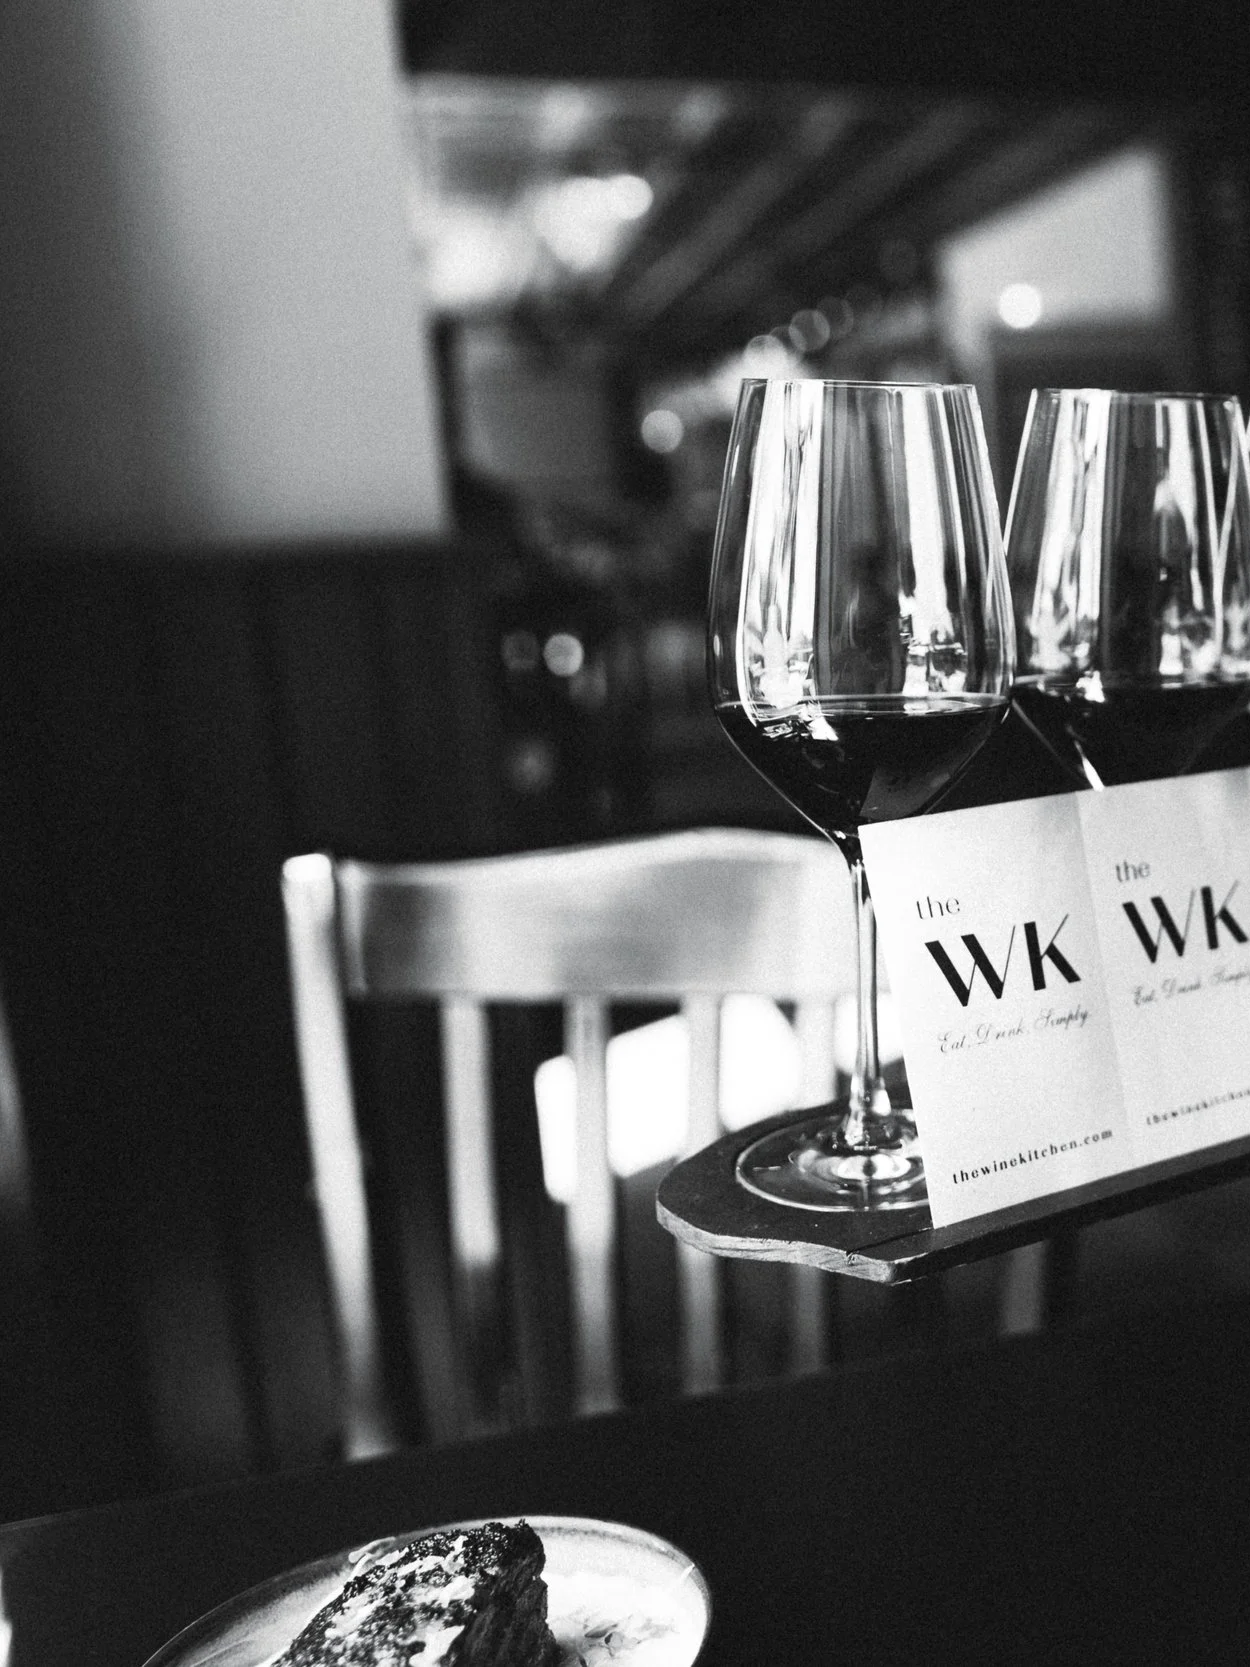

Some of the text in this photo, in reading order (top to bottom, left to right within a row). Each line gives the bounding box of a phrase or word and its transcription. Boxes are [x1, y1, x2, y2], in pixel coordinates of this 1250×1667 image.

[1115, 860, 1151, 883] the
[916, 895, 961, 920] the
[1122, 879, 1250, 964] WK
[924, 912, 1082, 1008] WK
[952, 1128, 1113, 1184] thewinekitchen.com
